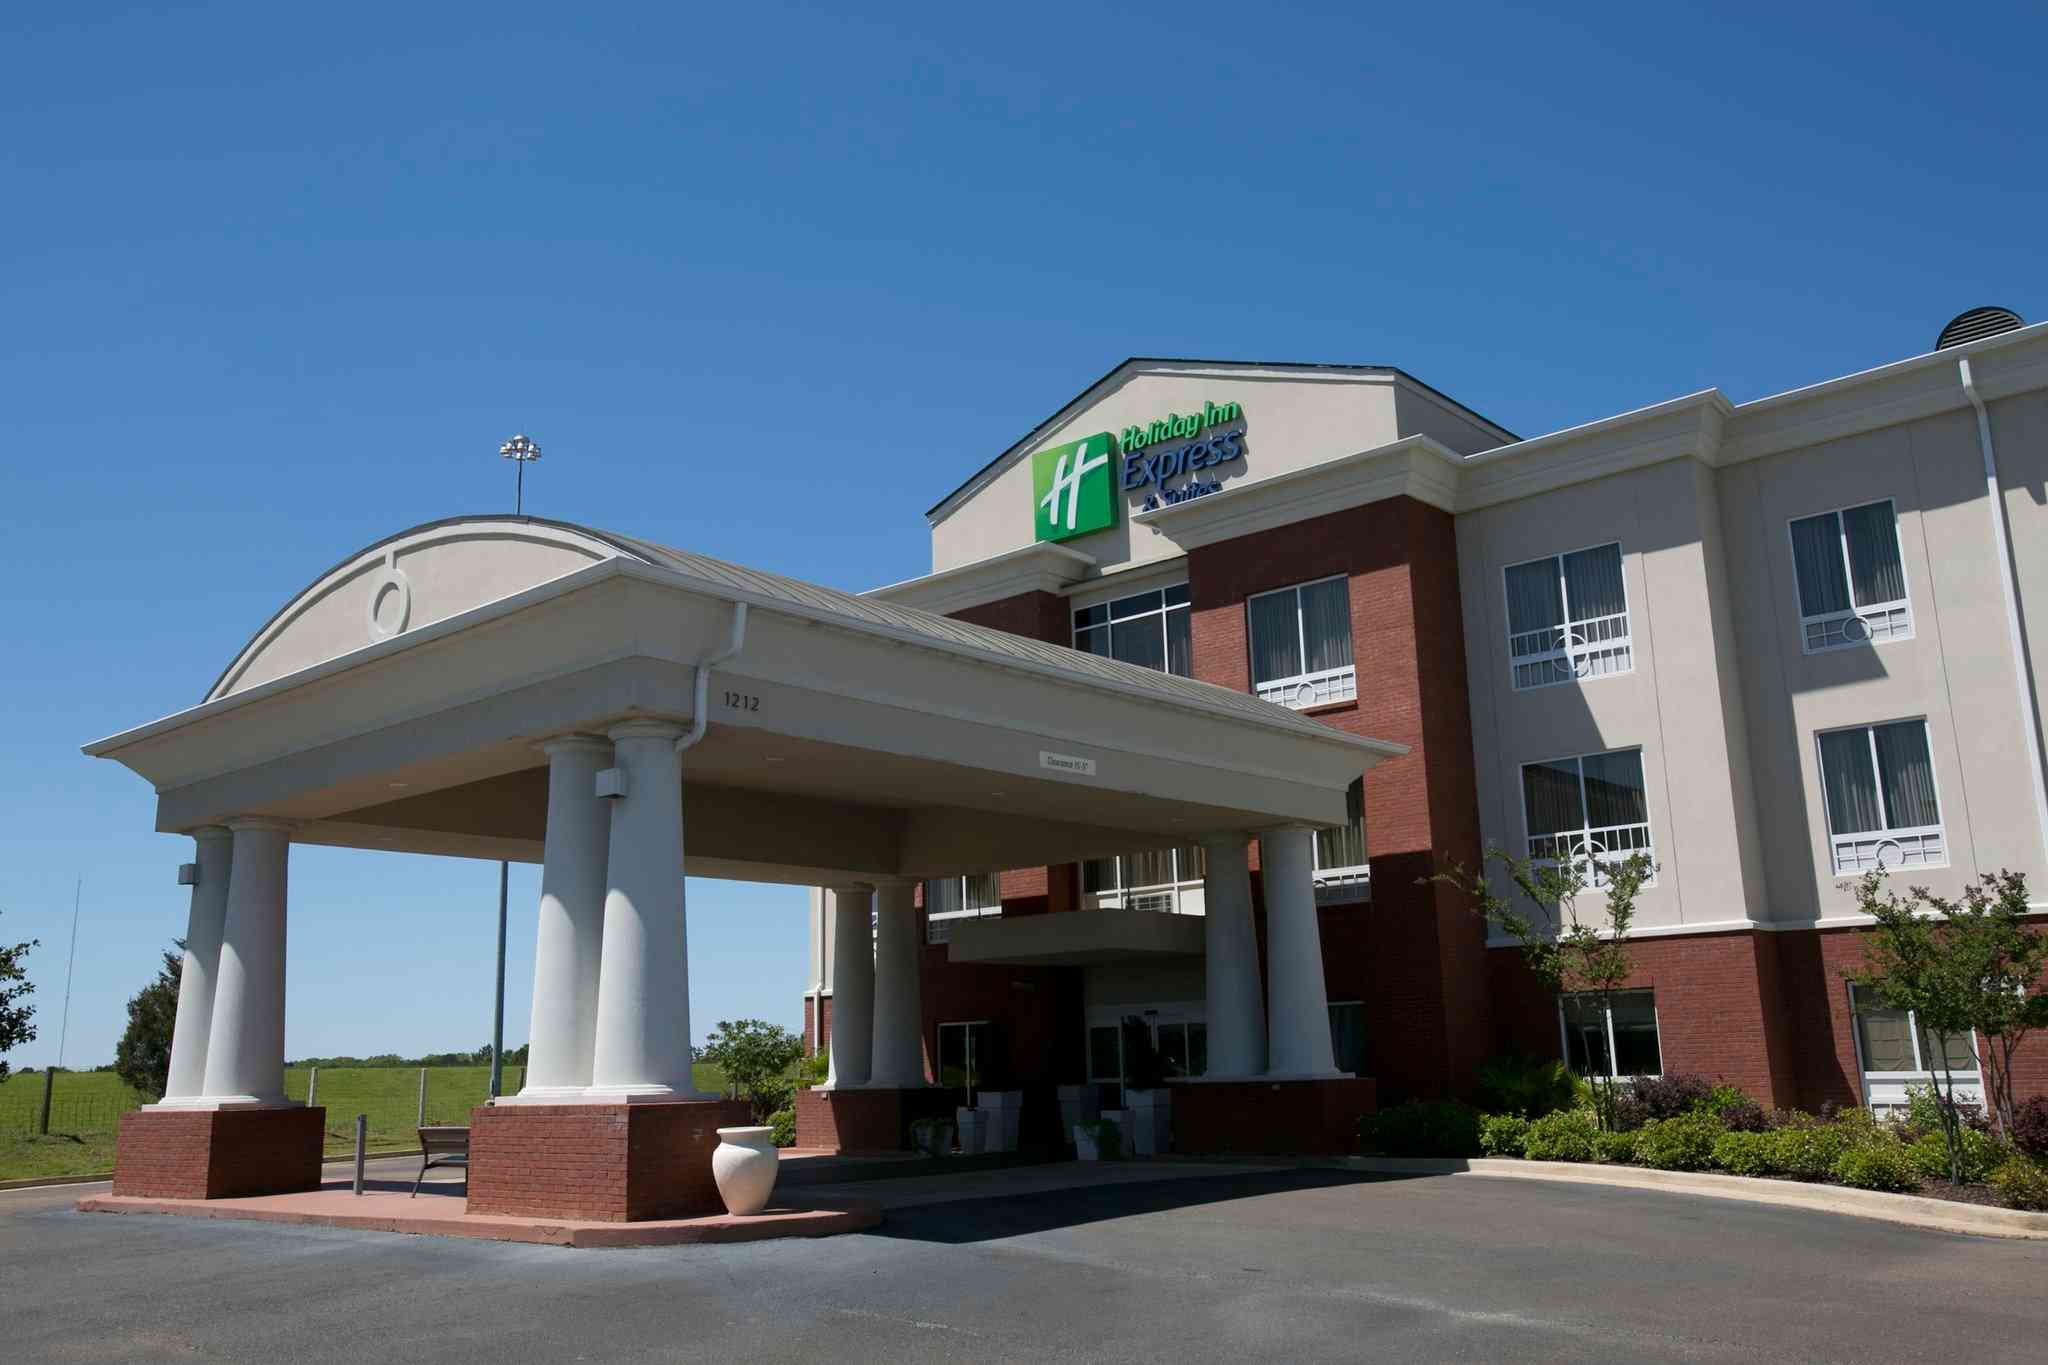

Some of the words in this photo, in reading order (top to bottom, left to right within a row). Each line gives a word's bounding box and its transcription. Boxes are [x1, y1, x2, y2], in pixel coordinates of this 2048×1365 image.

[1120, 413, 1201, 453] Holiday
[1203, 400, 1240, 428] Inn
[1121, 430, 1242, 491] Express
[725, 691, 760, 712] 1212
